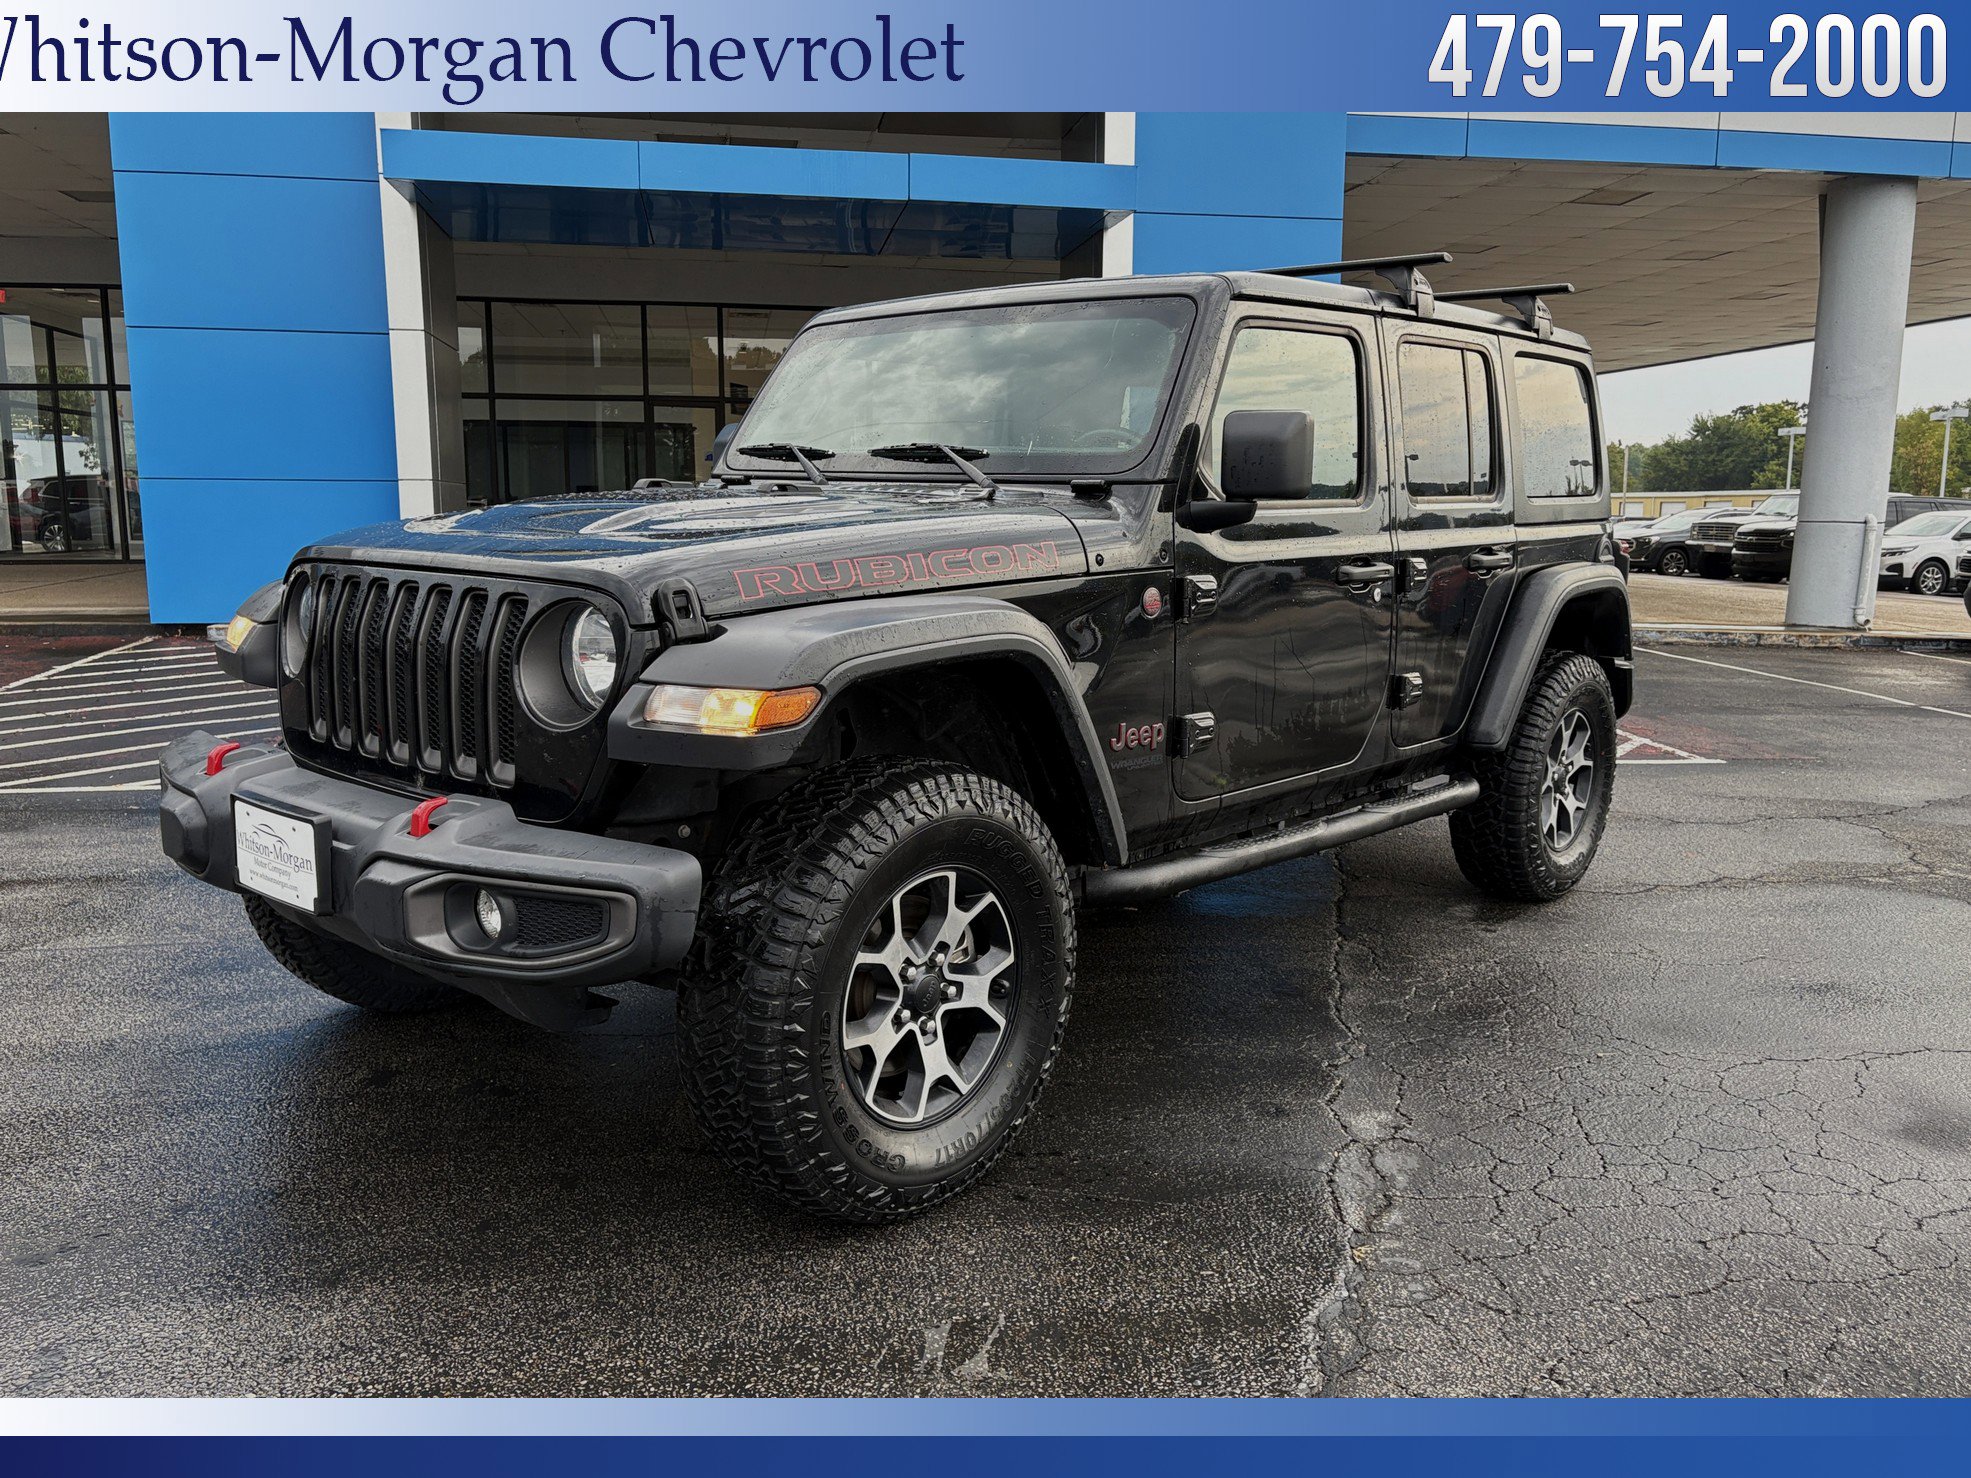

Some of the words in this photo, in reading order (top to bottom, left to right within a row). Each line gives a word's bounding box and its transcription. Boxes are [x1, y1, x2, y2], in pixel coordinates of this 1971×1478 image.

[733, 541, 1060, 600] RUBICON
[1110, 722, 1165, 752] Jeep
[1110, 754, 1164, 770] WRANGLER
[237, 832, 313, 874] Whitson-Morgan
[963, 828, 1044, 900] RUGGED
[819, 1010, 906, 1173] CROSSWIND
